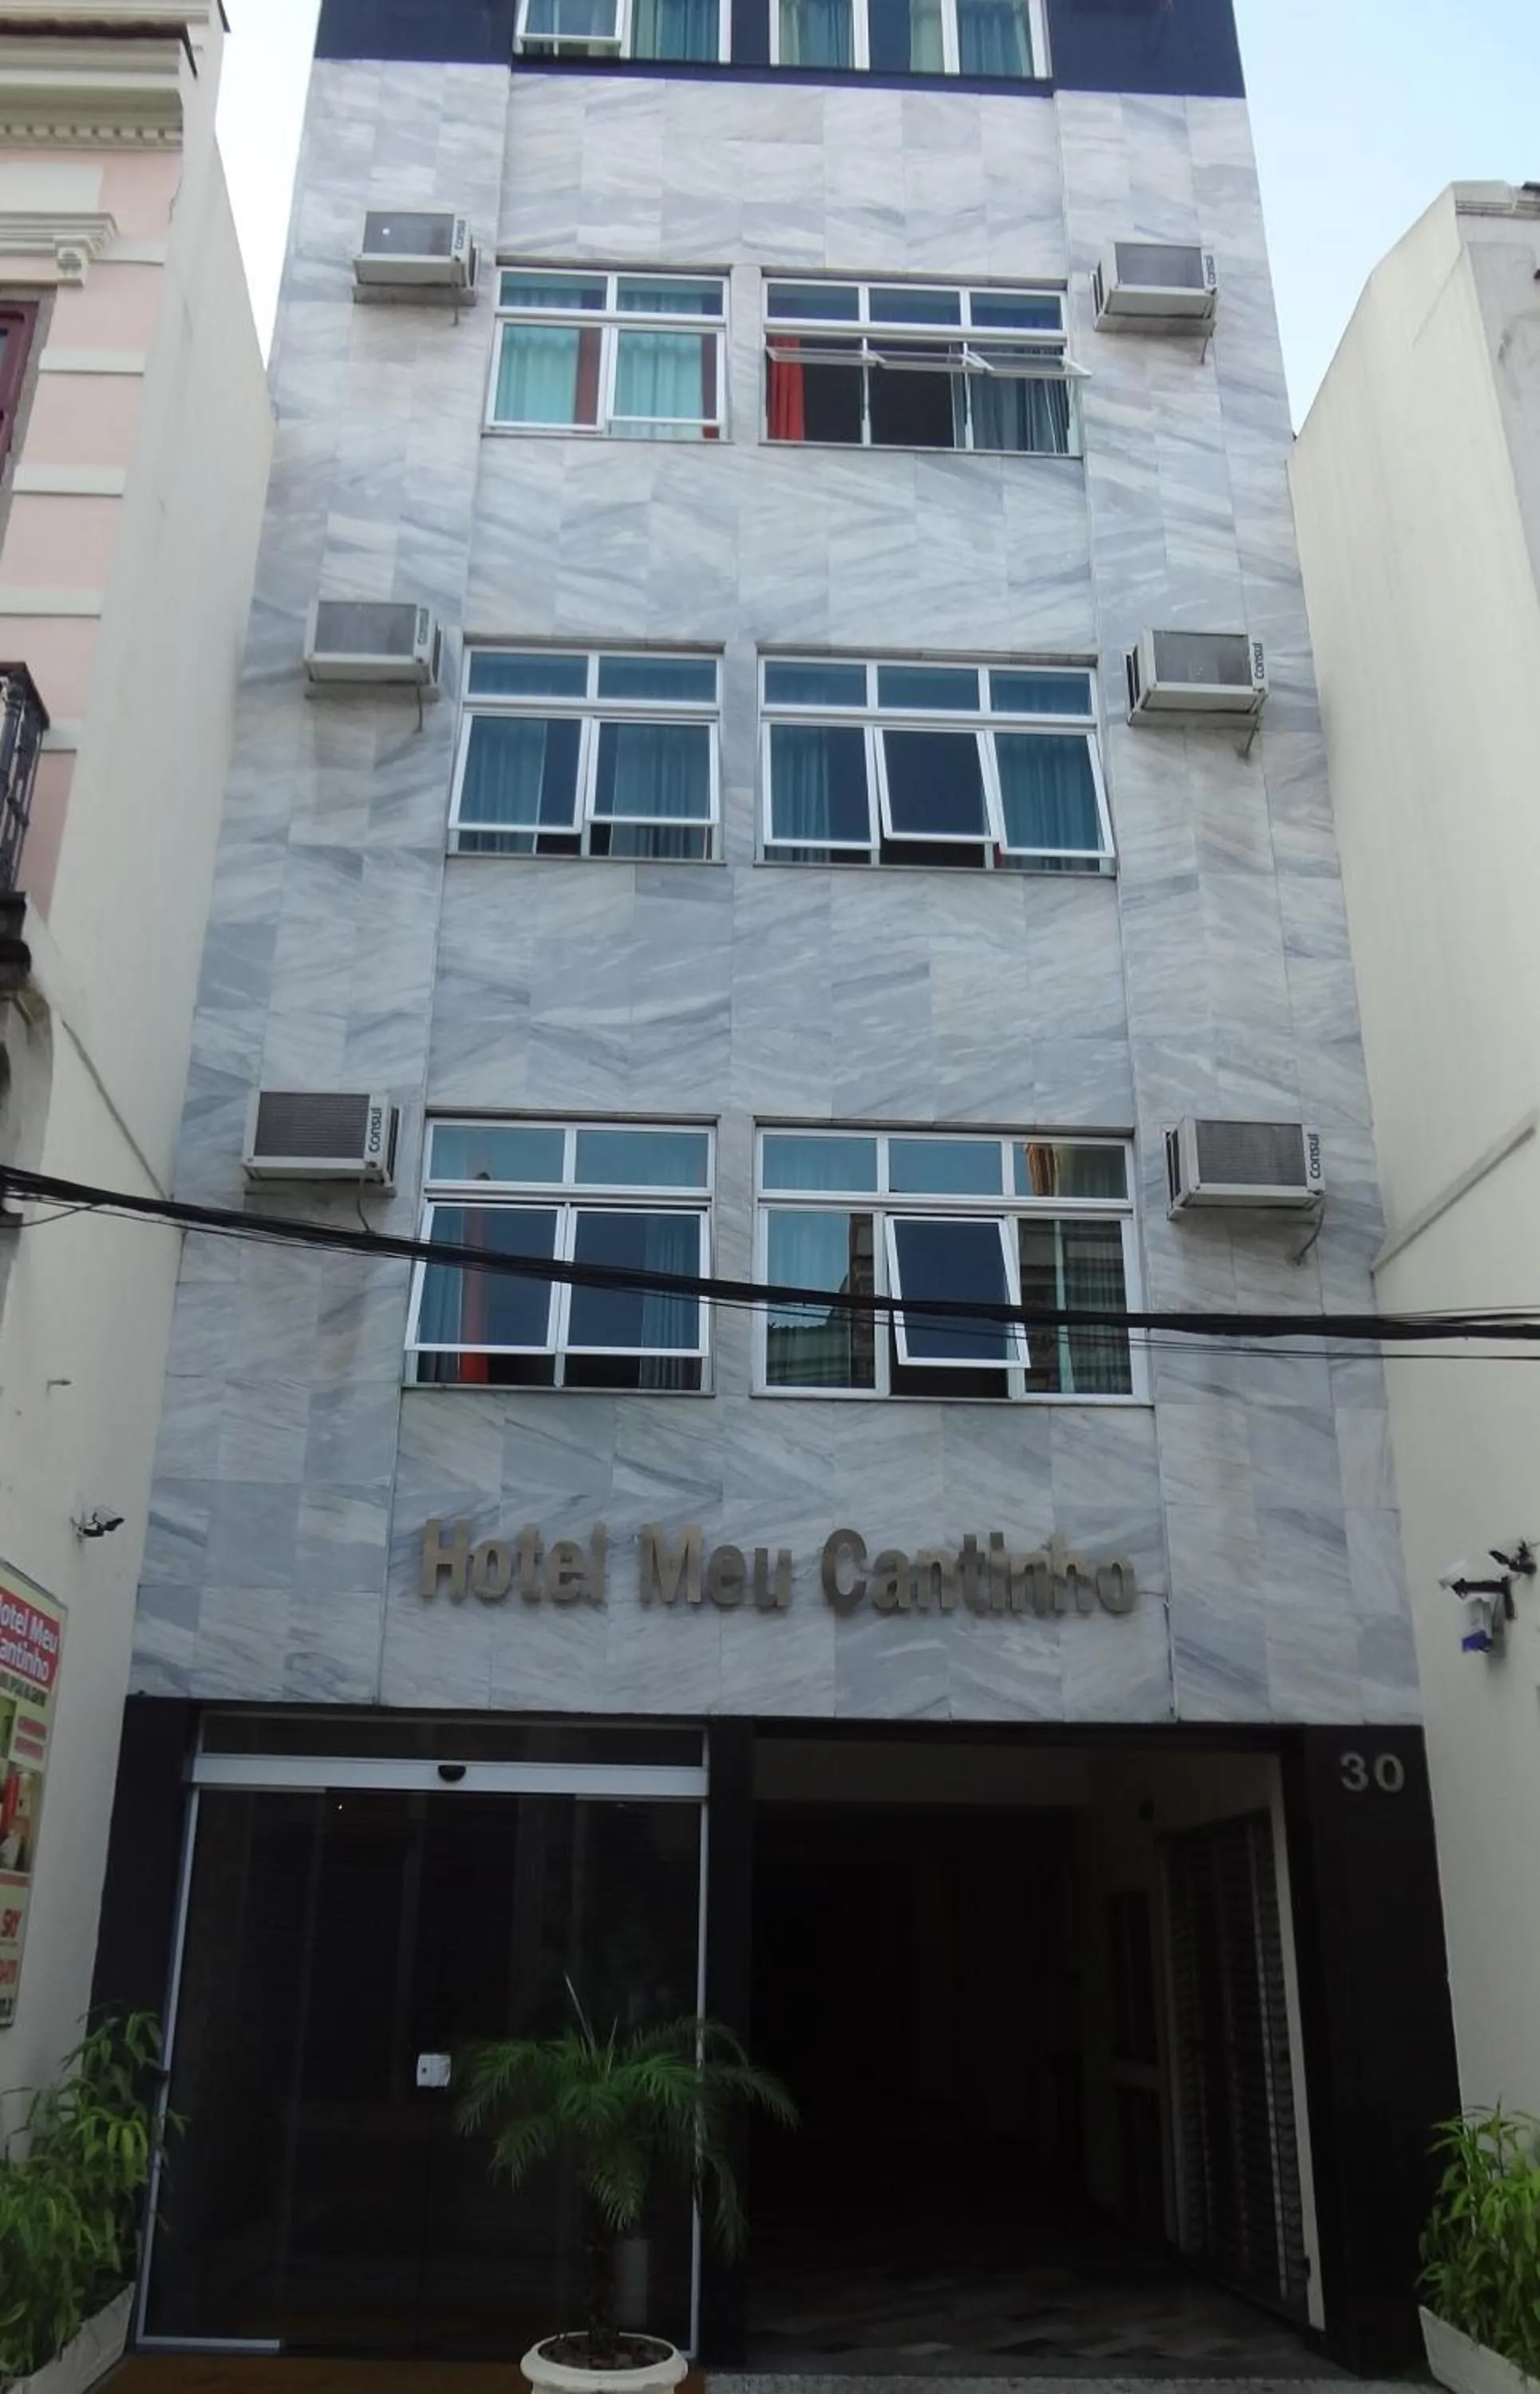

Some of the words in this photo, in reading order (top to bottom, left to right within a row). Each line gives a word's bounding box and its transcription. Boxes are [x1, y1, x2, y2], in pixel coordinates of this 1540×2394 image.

[421, 1518, 608, 1603] Hotel
[639, 1523, 792, 1610] Meu
[821, 1528, 1136, 1614] Cantinho
[0, 1594, 30, 1637] otel
[29, 1615, 58, 1654] Meu
[0, 1634, 49, 1682] antinho
[1340, 1752, 1405, 1792] 30
